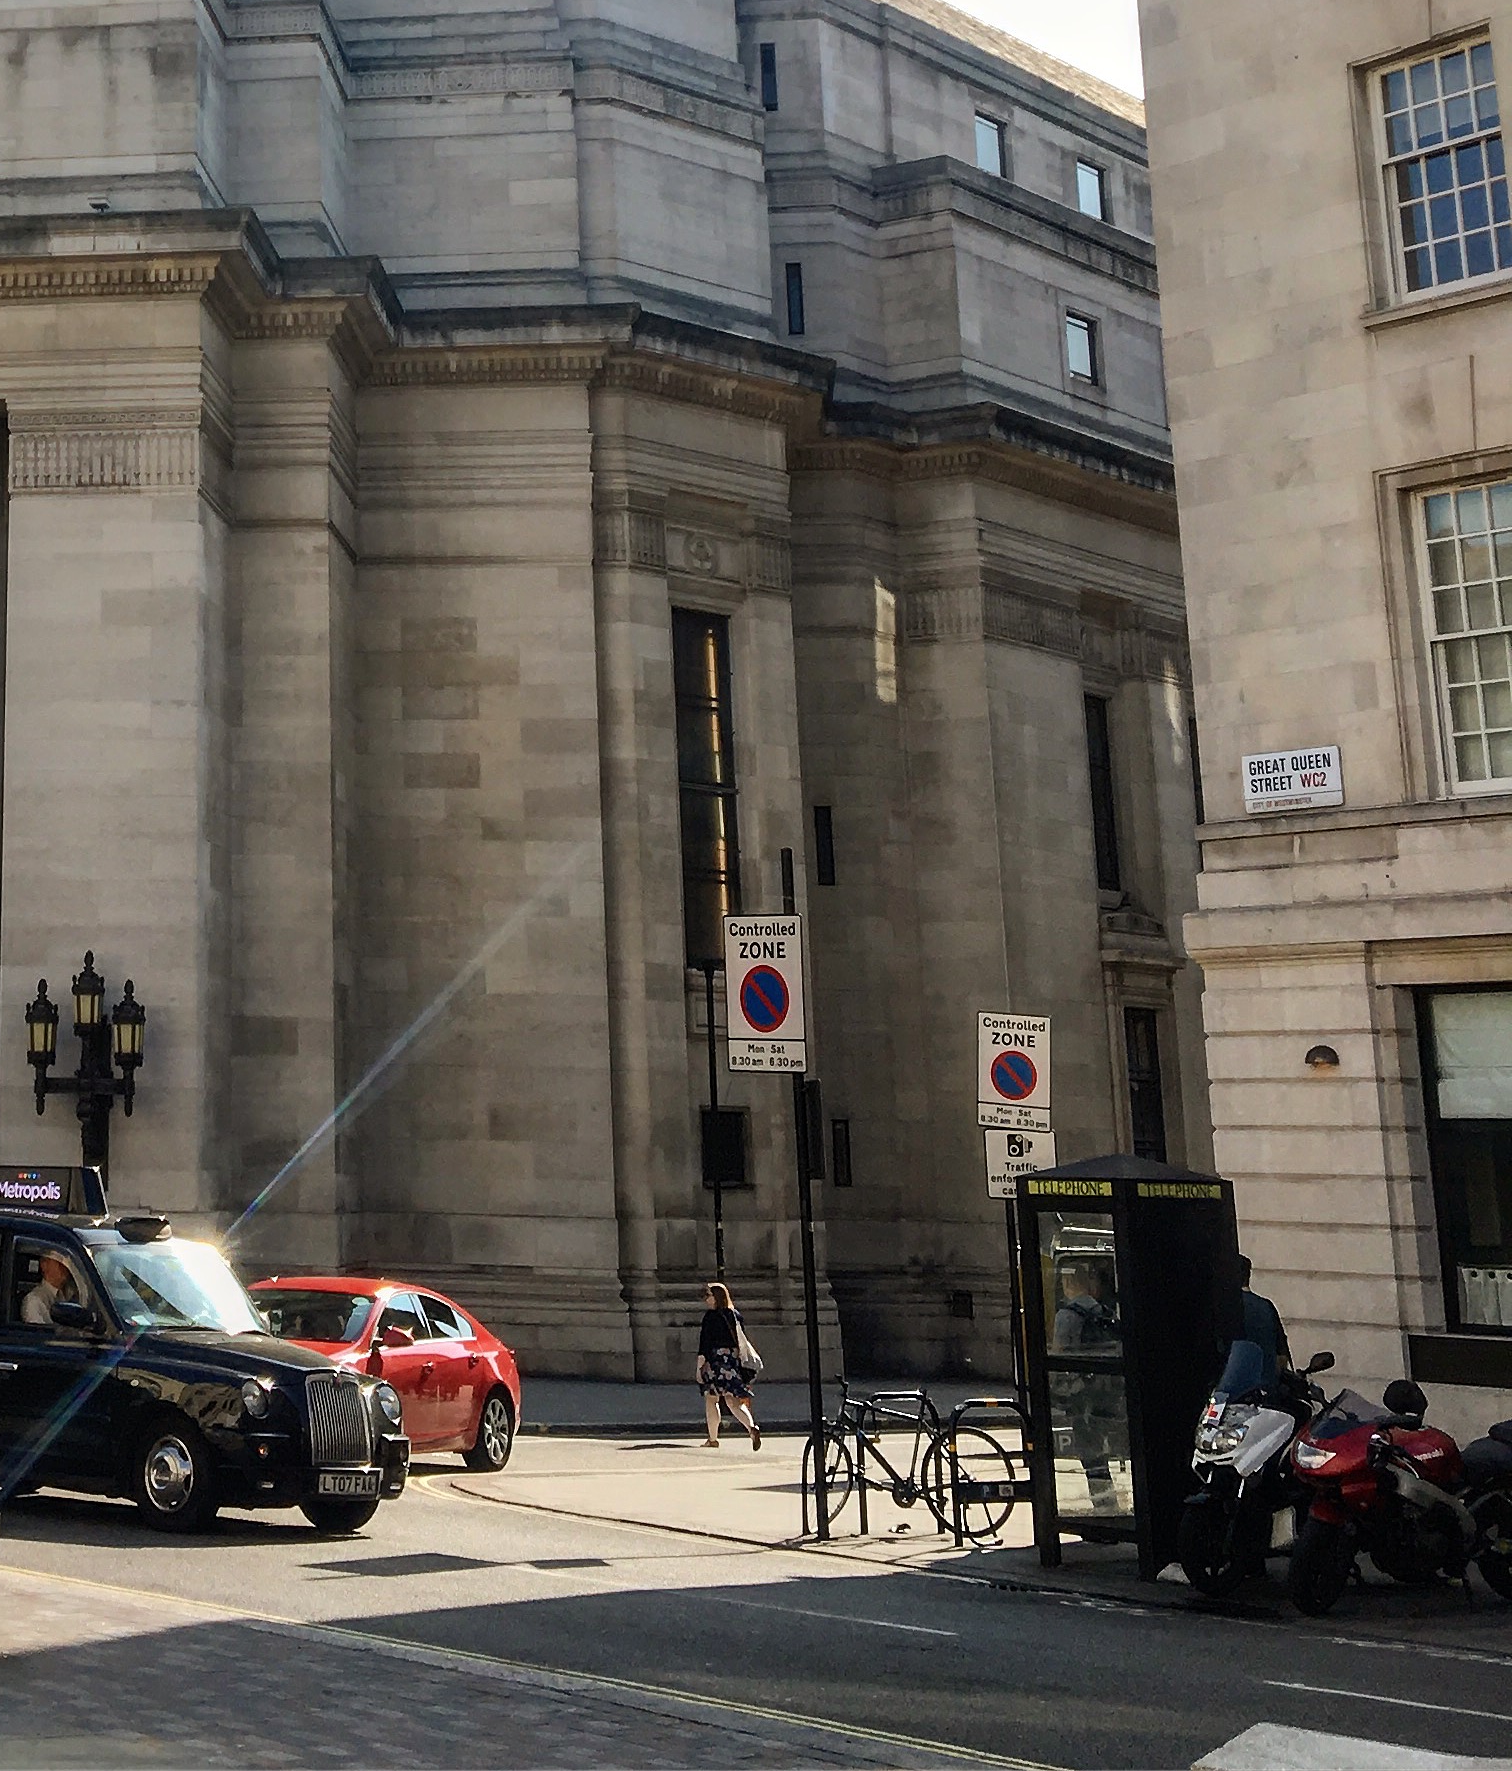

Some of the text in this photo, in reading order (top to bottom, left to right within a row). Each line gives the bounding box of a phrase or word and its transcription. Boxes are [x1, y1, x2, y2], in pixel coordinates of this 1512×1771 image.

[1249, 753, 1331, 776] GREAT QUEEN
[1251, 772, 1327, 793] STREET WC2
[729, 922, 796, 936] Controlled
[739, 941, 786, 959] ZONE
[983, 1016, 1046, 1032] Controlled
[991, 1032, 1036, 1048] ZONE
[748, 1043, 786, 1054] Mon Sat
[996, 1107, 1032, 1118] Mon Sat
[1005, 1162, 1038, 1172] Traffic
[1036, 1180, 1105, 1196] TELEPHONE
[1144, 1182, 1212, 1198] TELEPHONE
